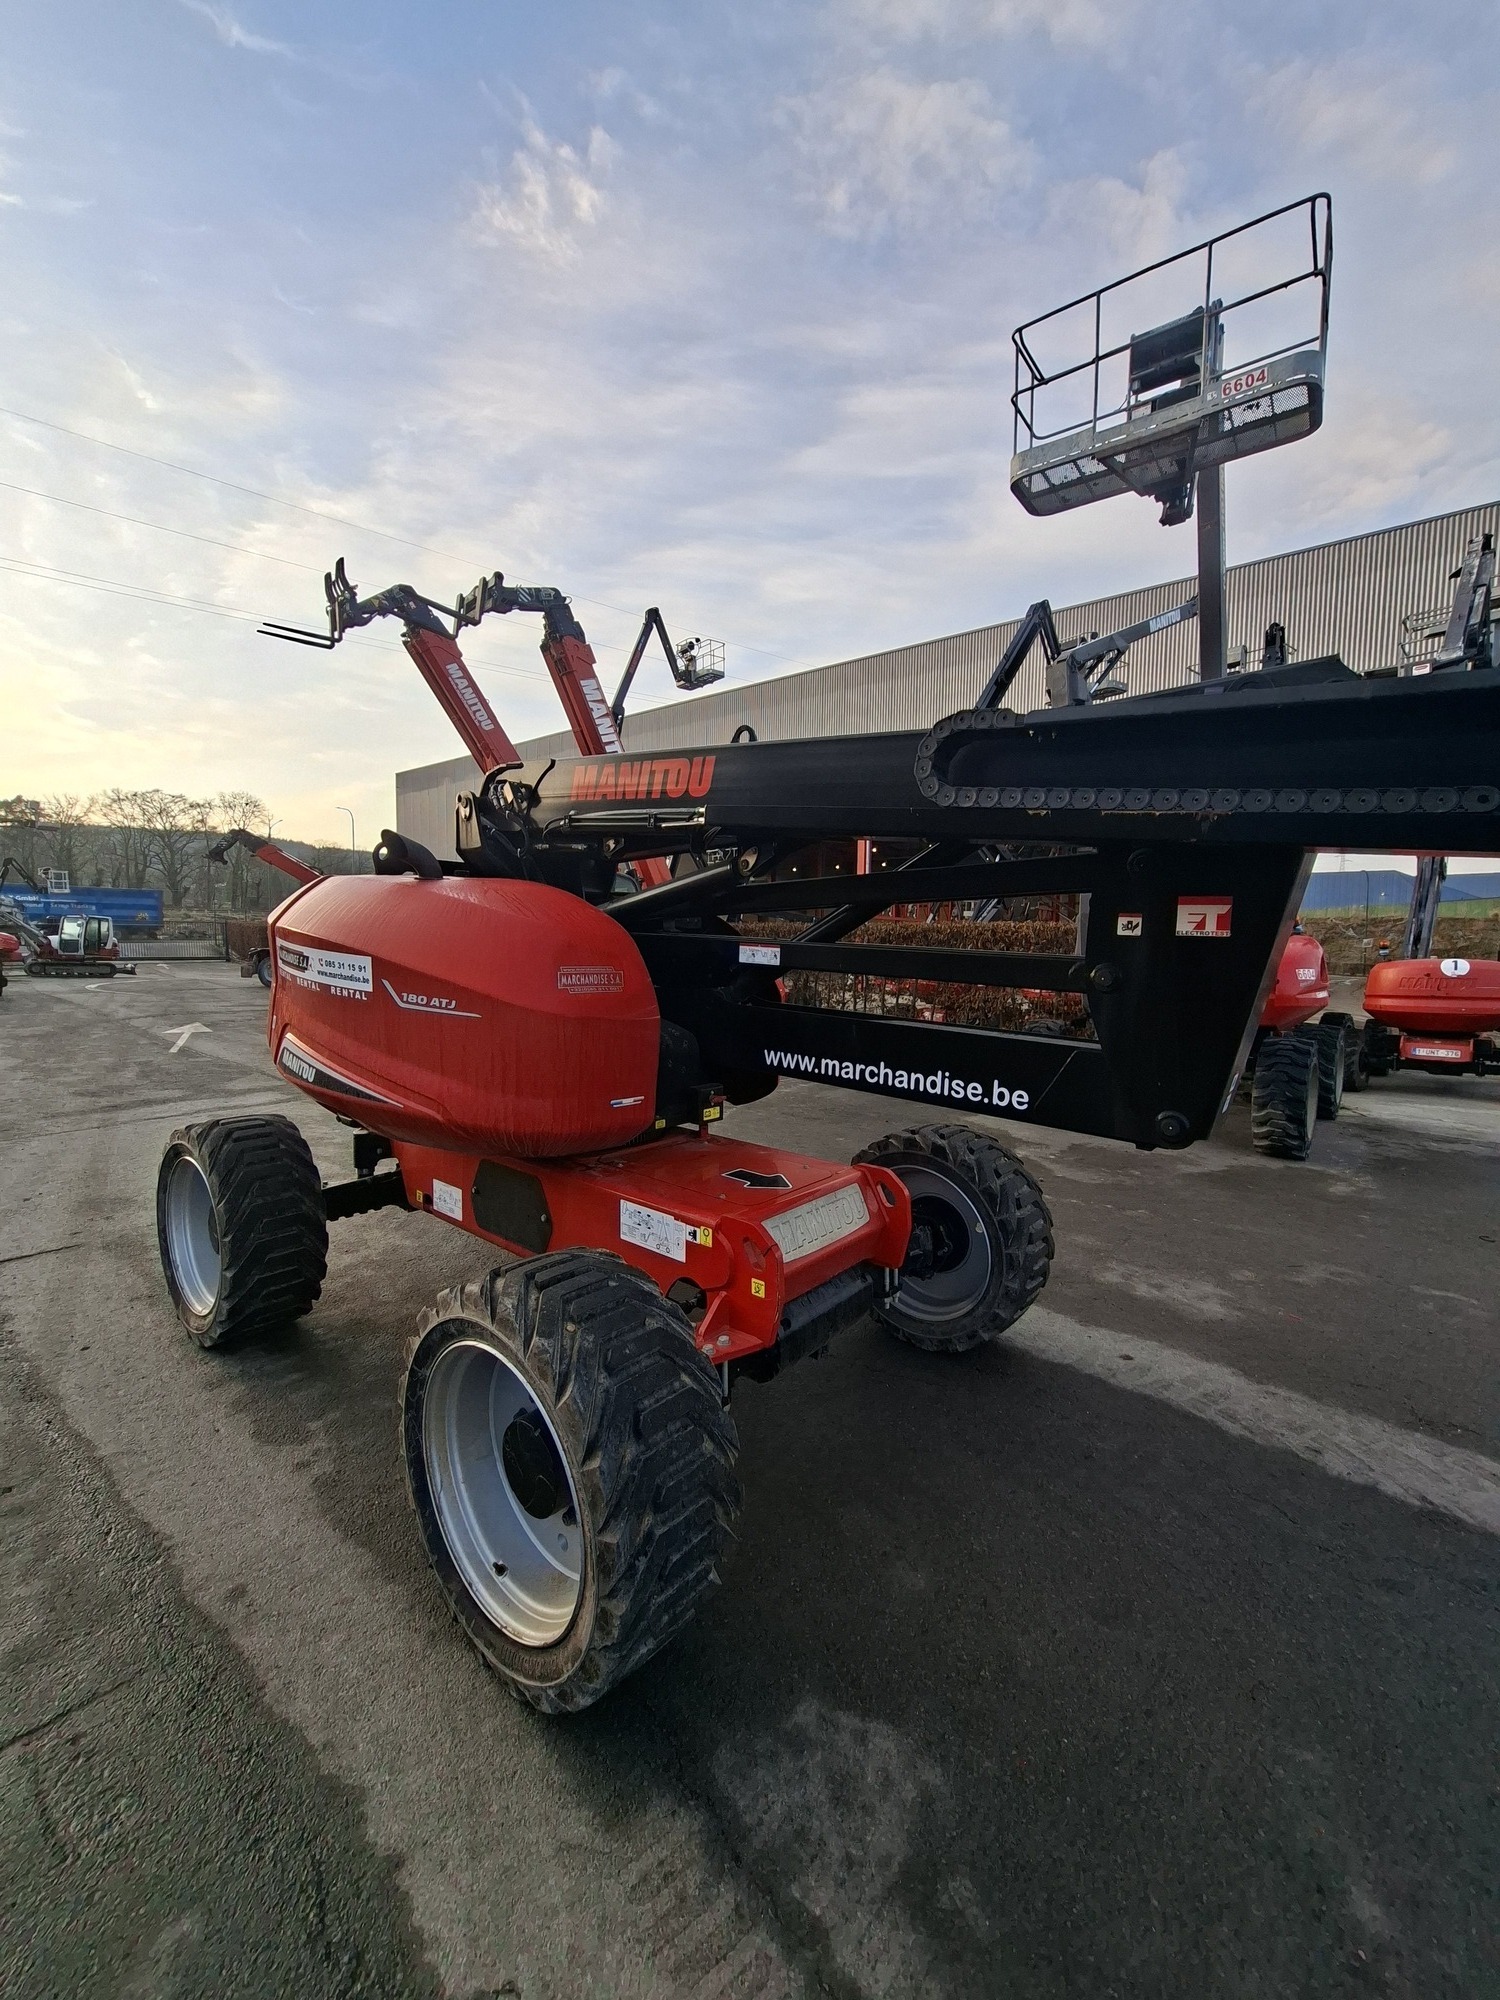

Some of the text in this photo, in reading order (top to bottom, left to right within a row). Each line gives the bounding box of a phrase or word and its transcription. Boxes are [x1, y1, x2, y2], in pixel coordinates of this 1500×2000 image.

[1222, 368, 1267, 397] 6604
[1149, 608, 1181, 633] MANITOU
[445, 662, 495, 731] MANITOU
[570, 755, 717, 801] MANITOU
[316, 969, 370, 985] www.marchandise.be
[324, 959, 367, 973] 085 31 15 91
[1451, 960, 1458, 971] 1
[561, 974, 608, 985] MARCHANDISE
[330, 986, 368, 1001] RENTAL
[401, 992, 457, 1009] 180 ATJ
[282, 1048, 317, 1083] MANITOU
[764, 1049, 1029, 1110] www.marchandise.be
[770, 1191, 866, 1255] MANITOU
